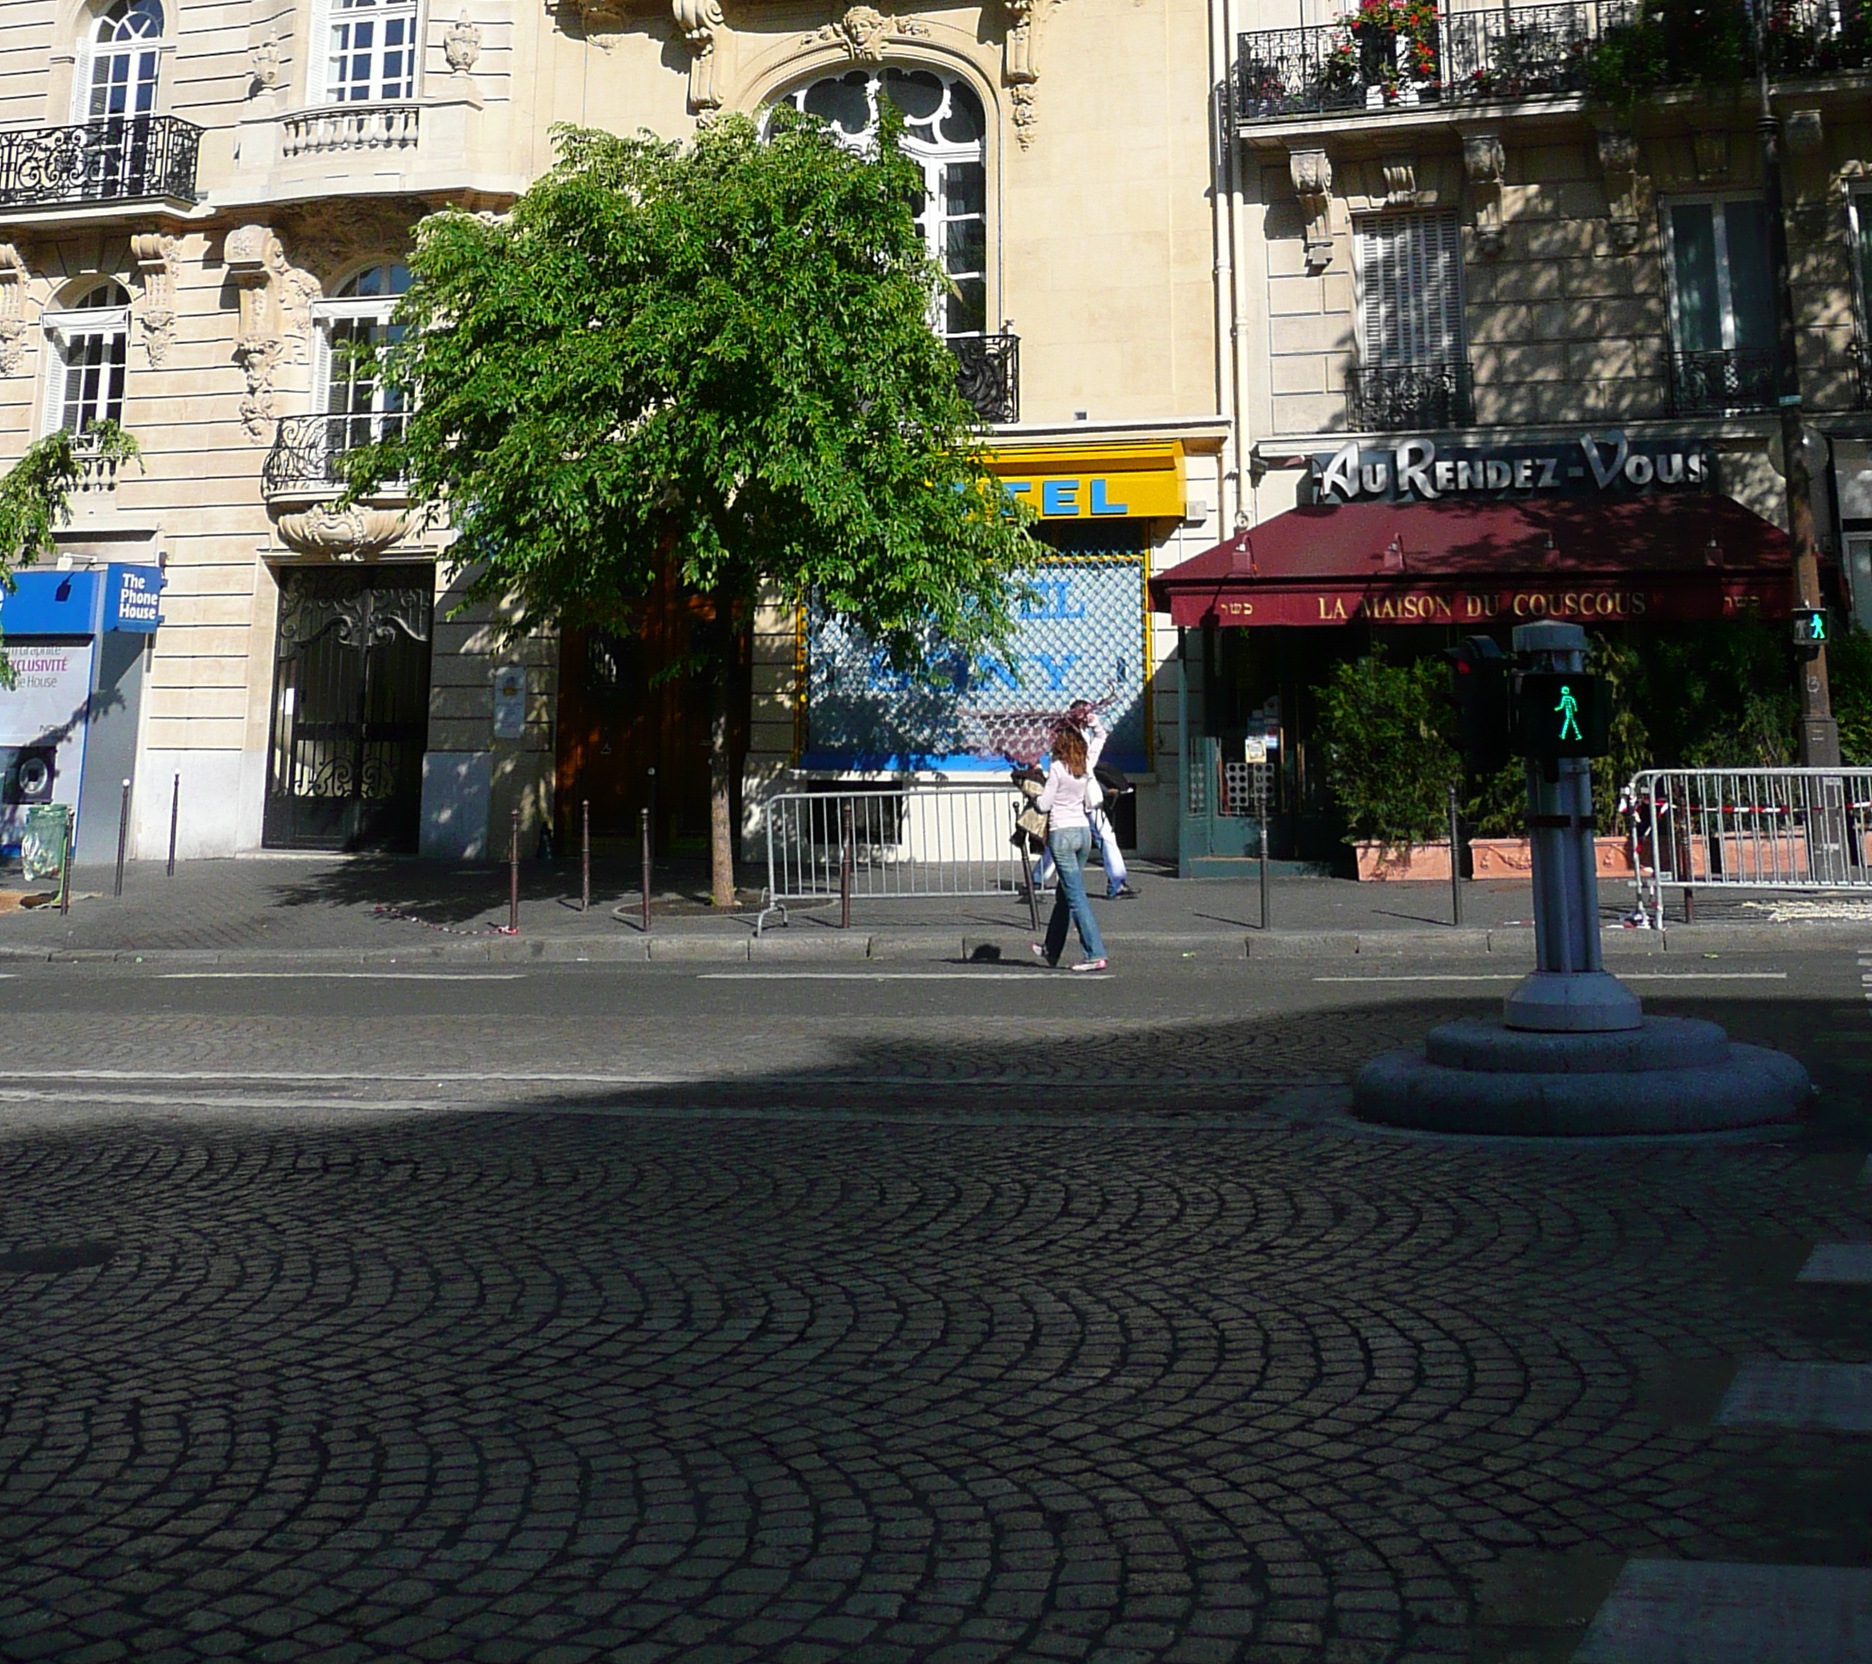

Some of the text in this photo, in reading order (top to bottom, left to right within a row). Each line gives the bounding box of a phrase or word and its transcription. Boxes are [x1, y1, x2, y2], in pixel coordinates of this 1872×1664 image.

[952, 479, 1129, 516] TEL
[122, 573, 146, 589] The
[120, 588, 158, 605] Phone
[119, 603, 157, 620] House
[1220, 602, 1253, 615] כשר
[1318, 592, 1646, 620] LA MAISON DU COUSCOUS
[9, 656, 68, 672] XCLUSIVITÉ
[27, 675, 57, 688] House
